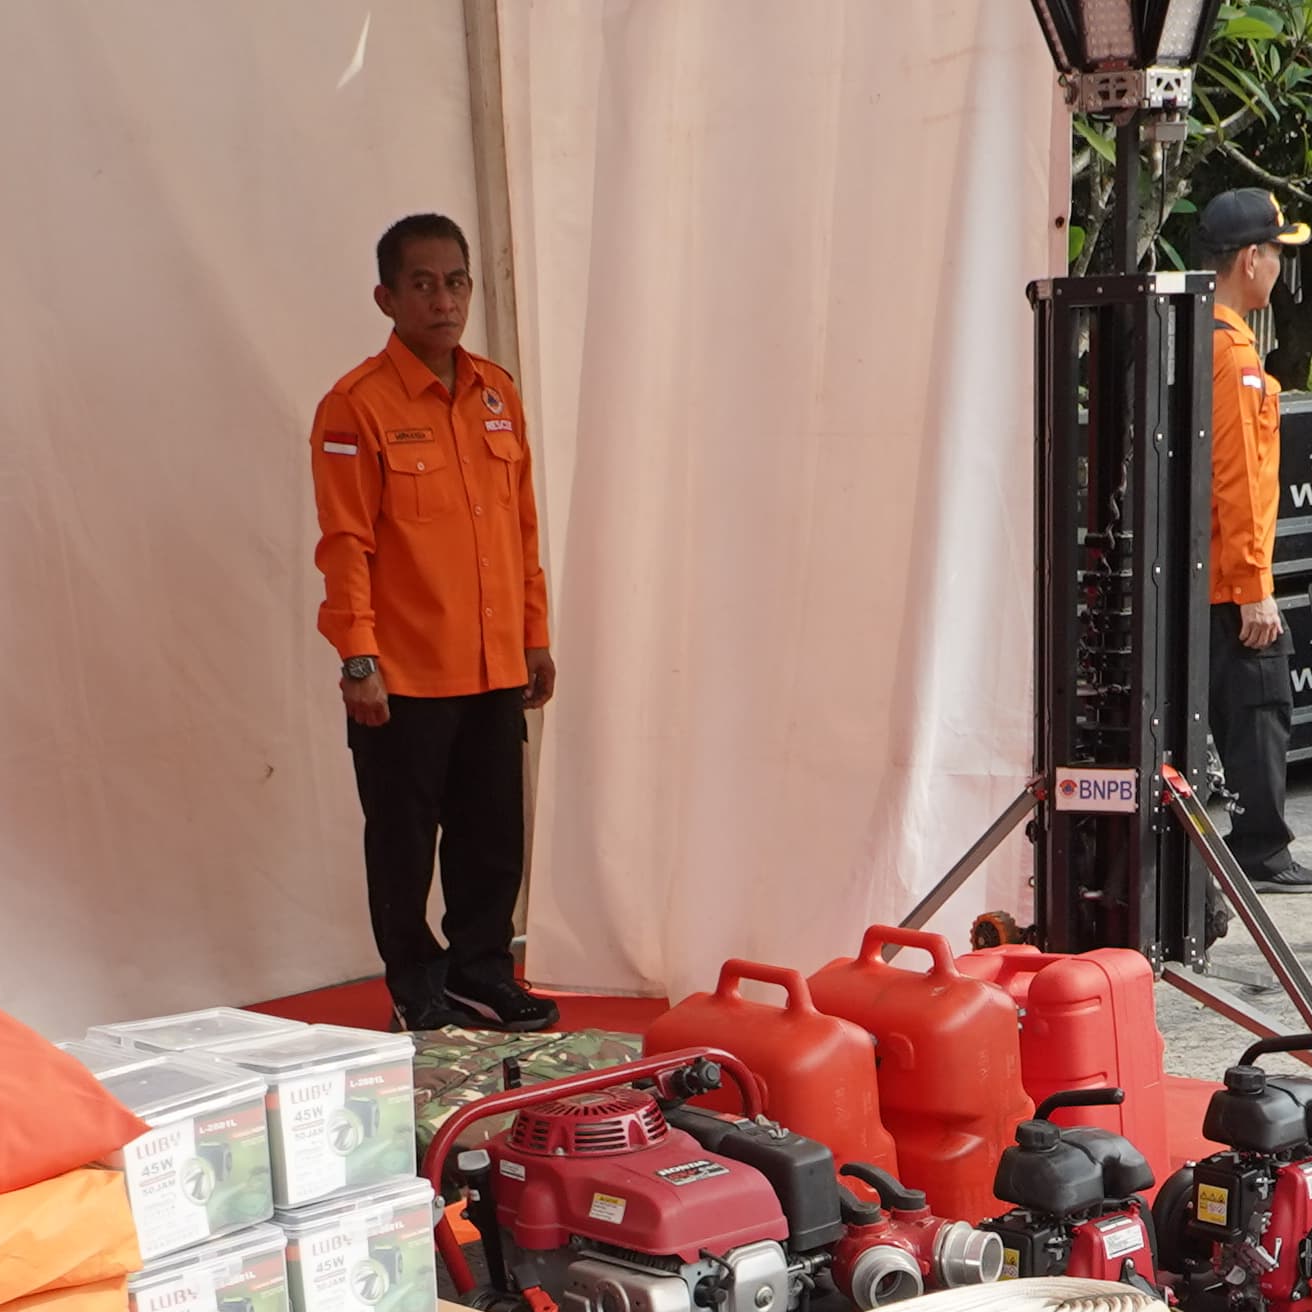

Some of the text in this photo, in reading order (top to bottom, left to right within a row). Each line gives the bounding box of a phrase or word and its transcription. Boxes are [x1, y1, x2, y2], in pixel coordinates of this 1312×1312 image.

[1079, 780, 1132, 800] BNPB
[290, 1081, 333, 1105] LUBY
[295, 1105, 324, 1122] 45W
[136, 1131, 181, 1160] LUBY
[142, 1158, 174, 1177] 45W
[657, 1160, 711, 1176] HONDA
[316, 1255, 345, 1272] 45W
